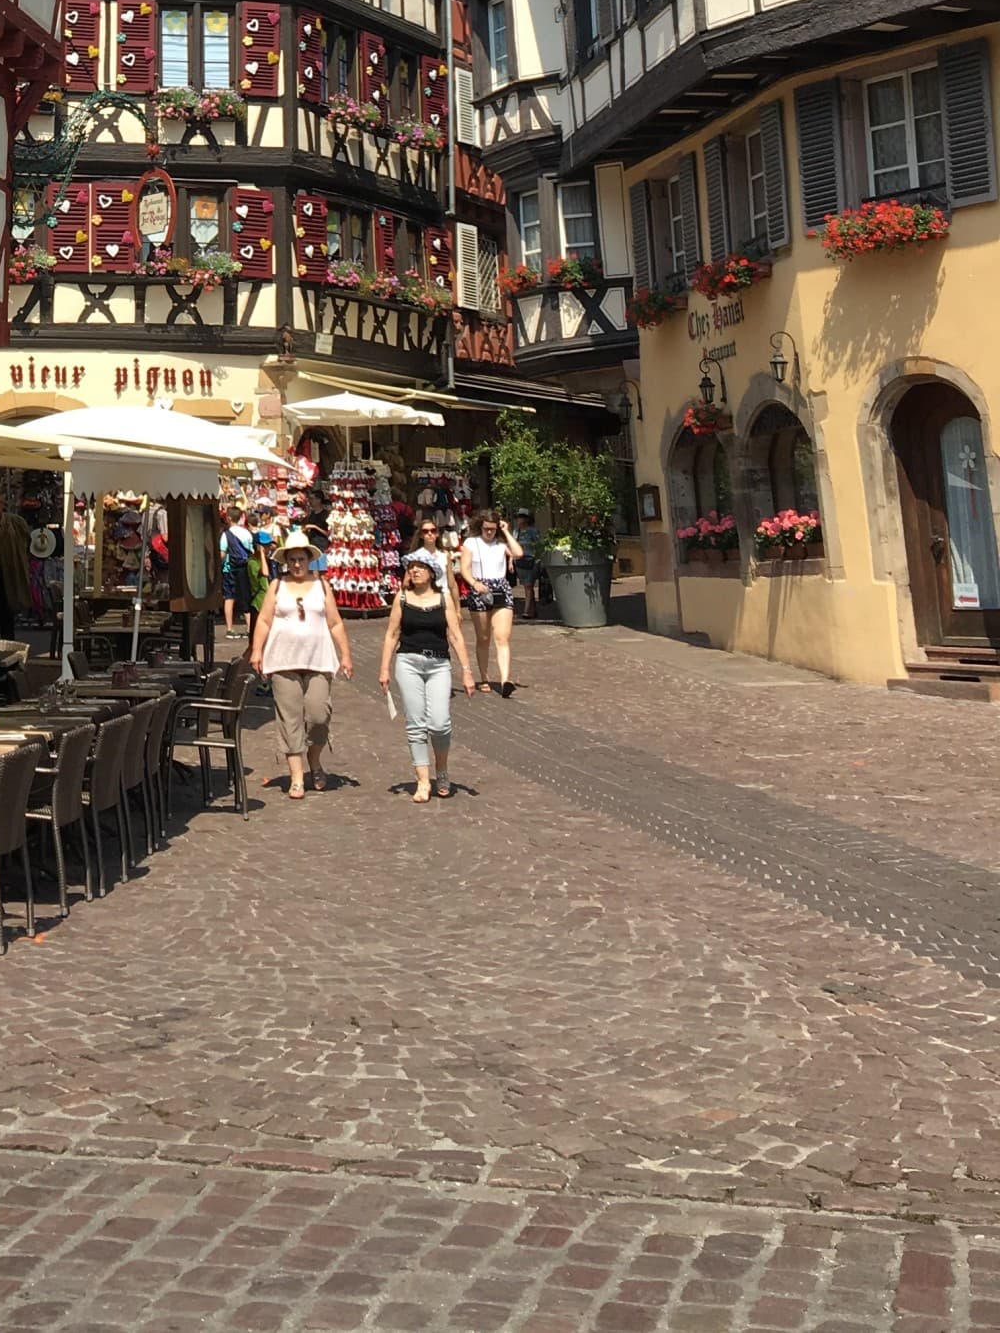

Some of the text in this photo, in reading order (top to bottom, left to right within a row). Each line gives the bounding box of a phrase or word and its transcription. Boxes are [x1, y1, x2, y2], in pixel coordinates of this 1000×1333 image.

[687, 309, 710, 343] Chez
[9, 355, 86, 385] vieux
[114, 357, 213, 395] pignon
